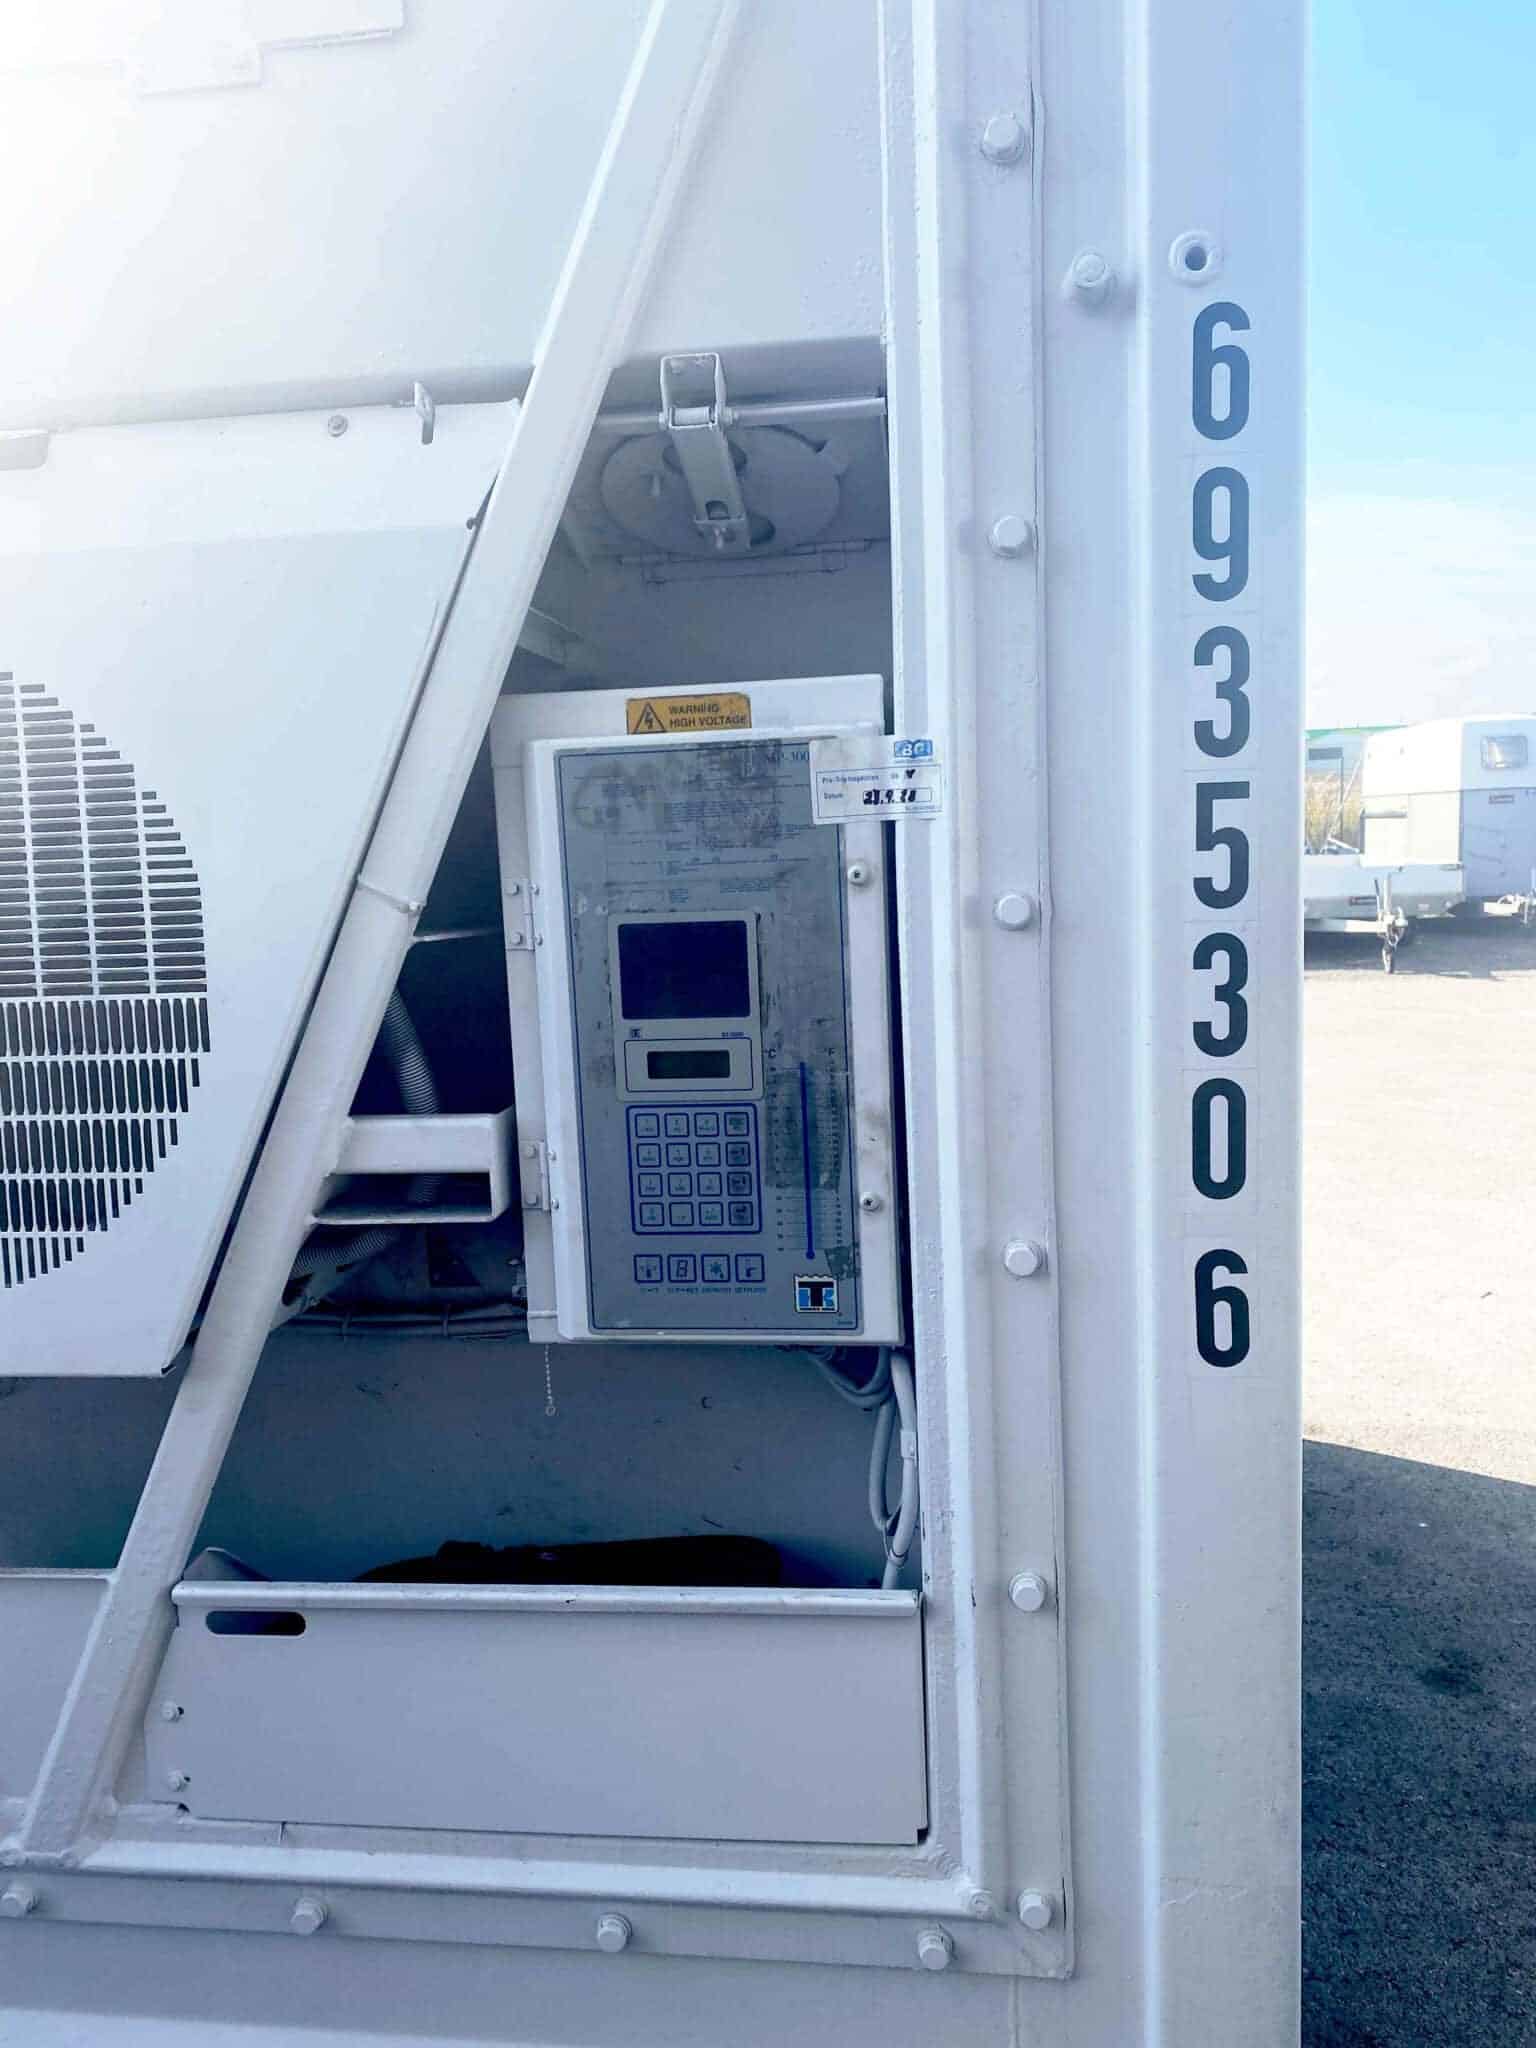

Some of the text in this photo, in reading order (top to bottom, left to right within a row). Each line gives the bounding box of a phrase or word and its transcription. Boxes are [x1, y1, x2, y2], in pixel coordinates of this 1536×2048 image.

[668, 702, 720, 715] WARNING
[668, 714, 748, 729] HIGH VOLTAGE
[1191, 301, 1252, 1369] 6935306
